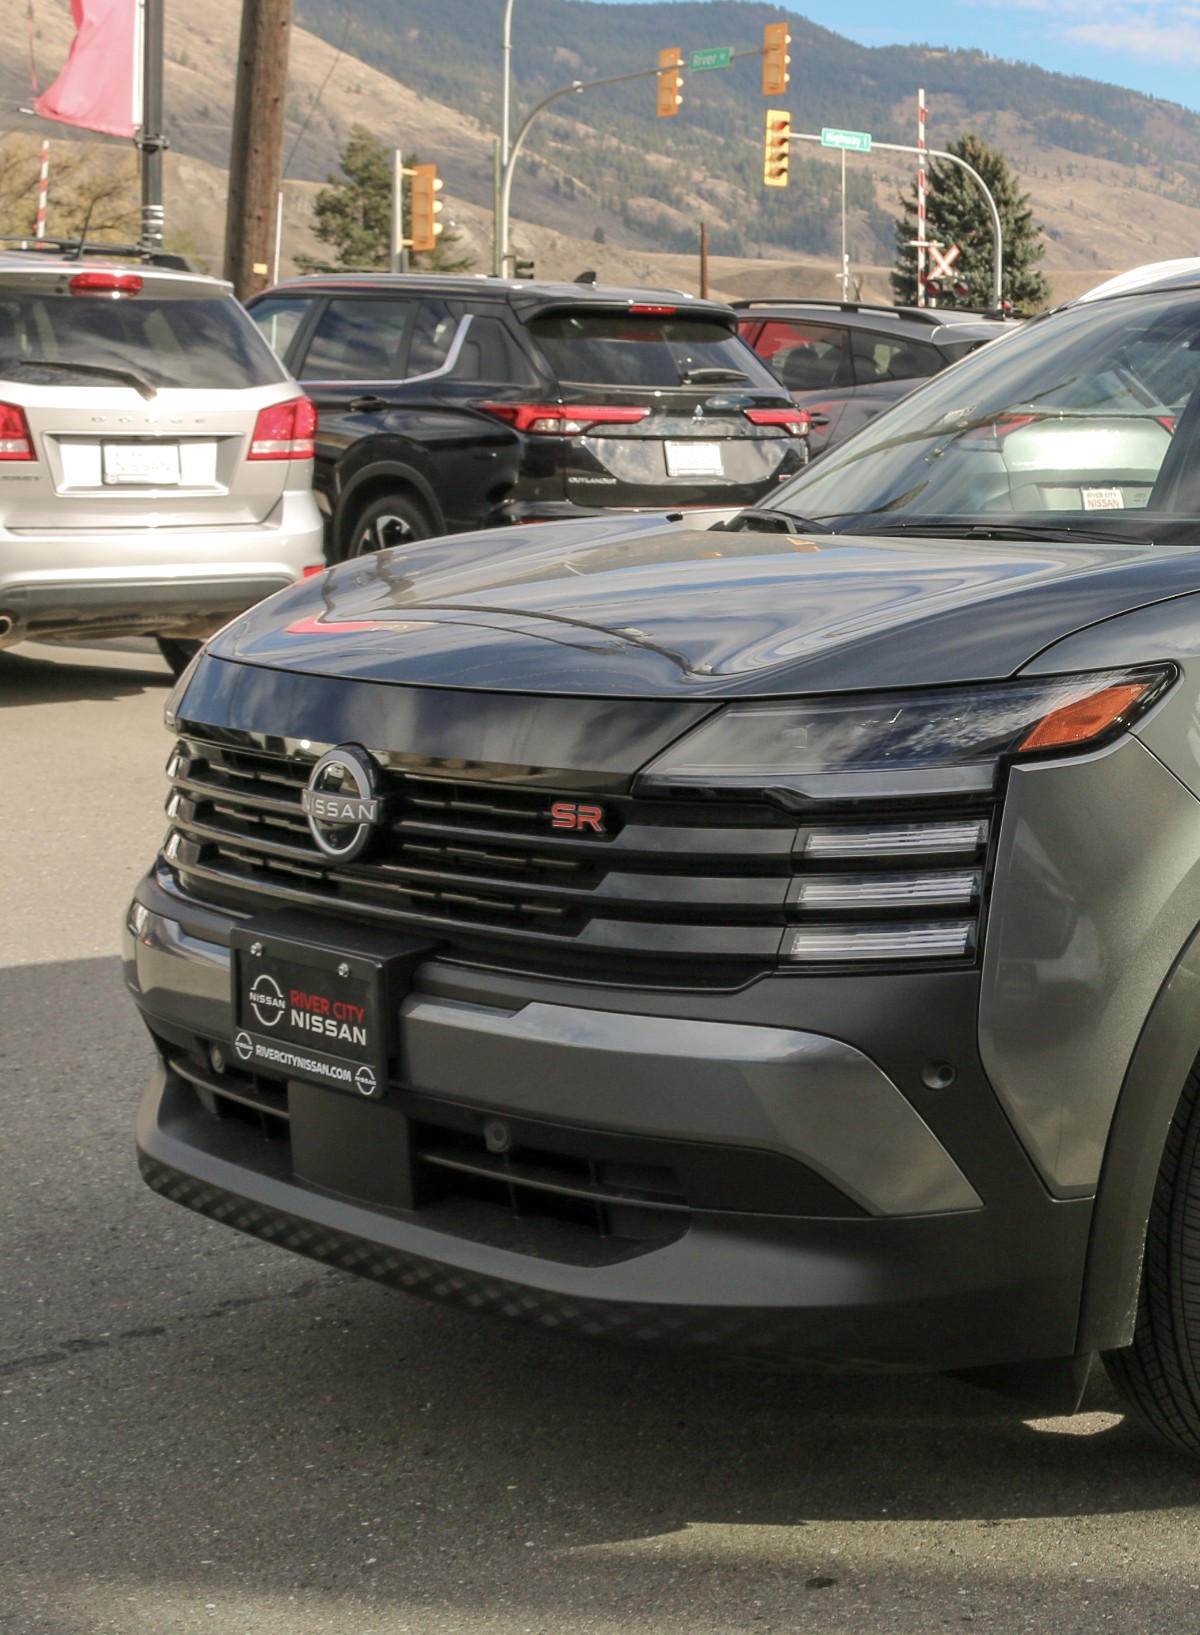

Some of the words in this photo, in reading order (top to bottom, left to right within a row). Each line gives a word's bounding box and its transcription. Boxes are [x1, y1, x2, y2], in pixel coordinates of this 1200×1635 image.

[693, 54, 717, 66] River
[1088, 499, 1119, 508] NISSAN
[303, 794, 374, 820] NISSAN
[551, 803, 602, 831] SR
[249, 992, 286, 1009] NISSAN
[290, 989, 331, 1015] RIVER
[333, 1002, 366, 1024] CITY
[290, 1009, 367, 1046] NISSAN
[255, 1044, 352, 1082] RIVERCITYNISSAN.COM
[355, 1076, 377, 1086] NISSAN
